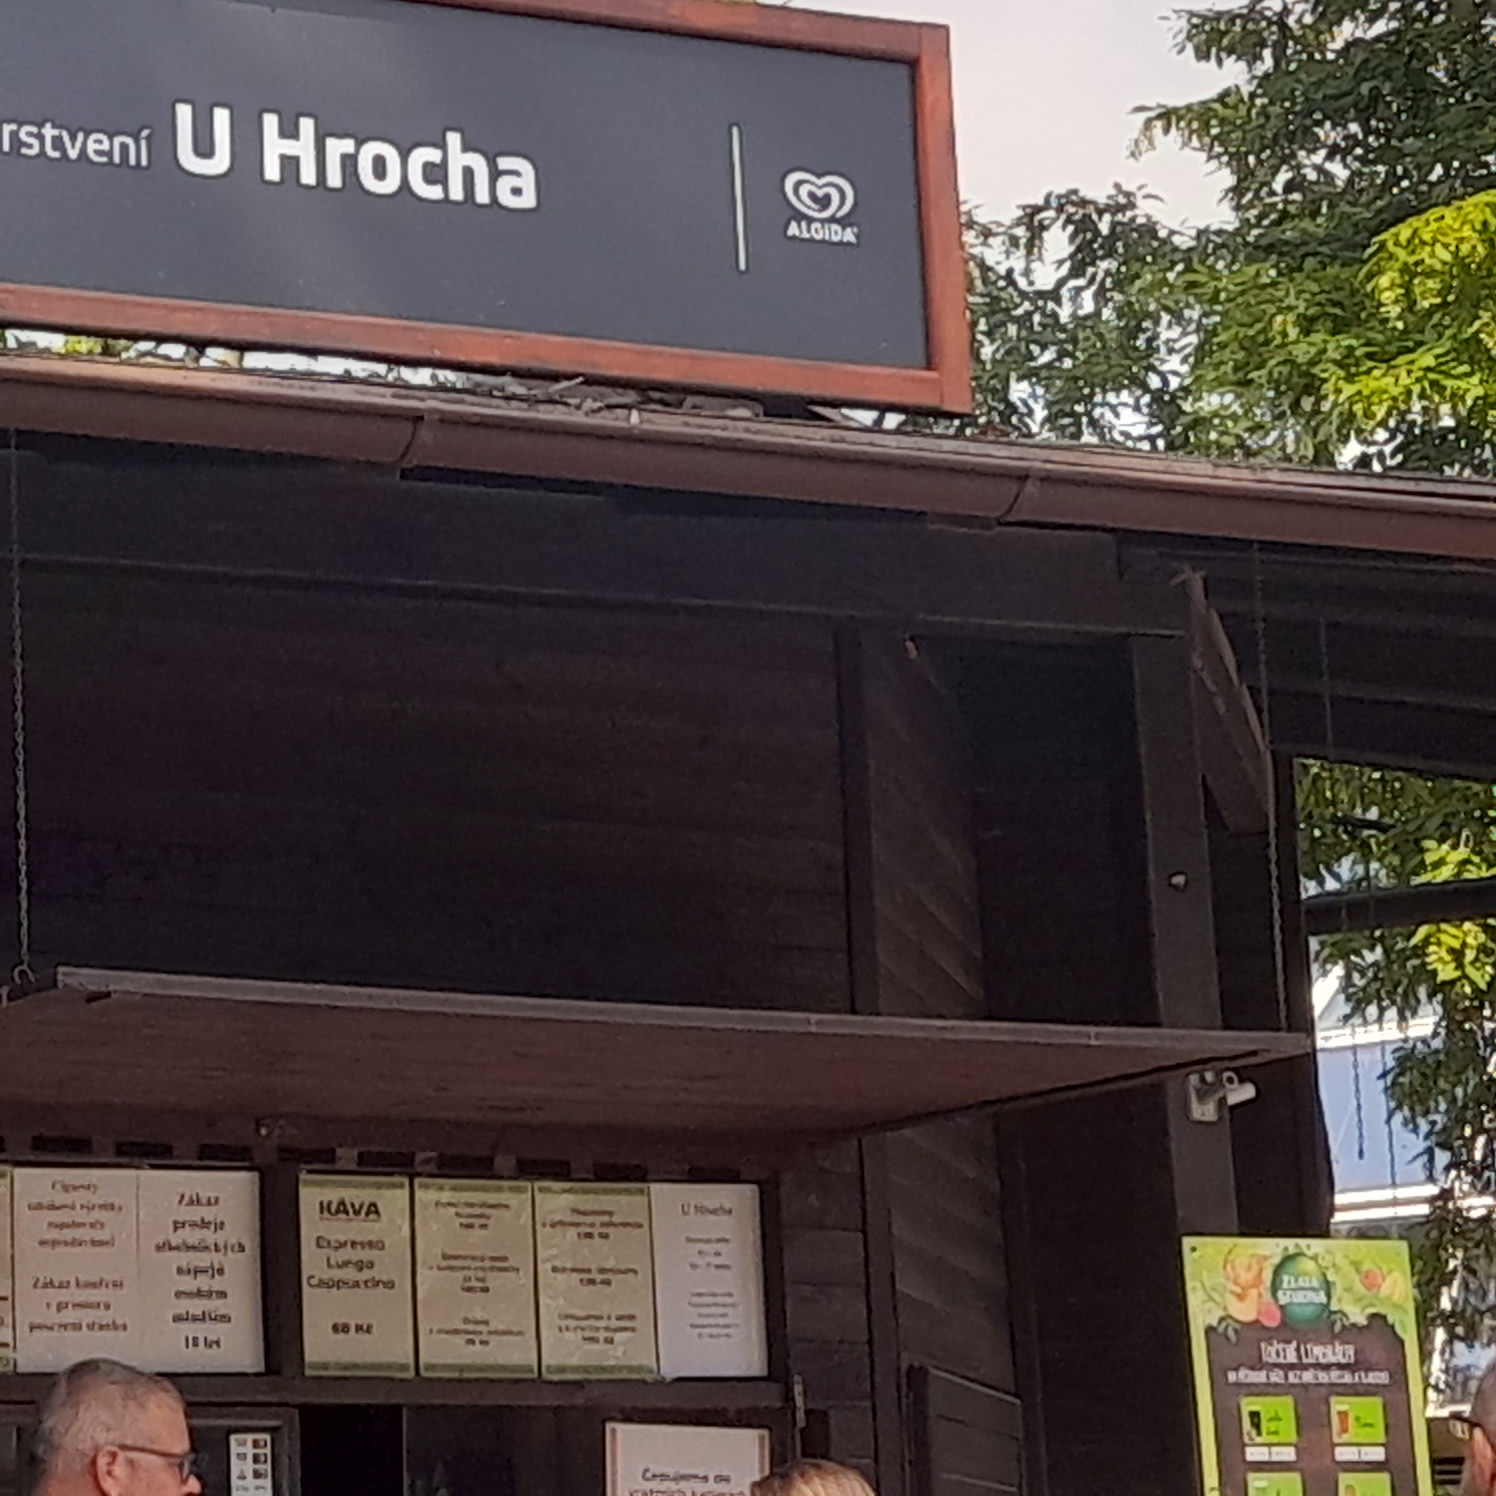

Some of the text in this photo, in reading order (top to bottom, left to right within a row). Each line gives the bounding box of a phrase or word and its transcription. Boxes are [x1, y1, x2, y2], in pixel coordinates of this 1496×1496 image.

[173, 101, 232, 176] U
[260, 111, 538, 209] Hrocha
[786, 219, 858, 244] ALGIDA
[318, 1197, 382, 1218] KÁVA
